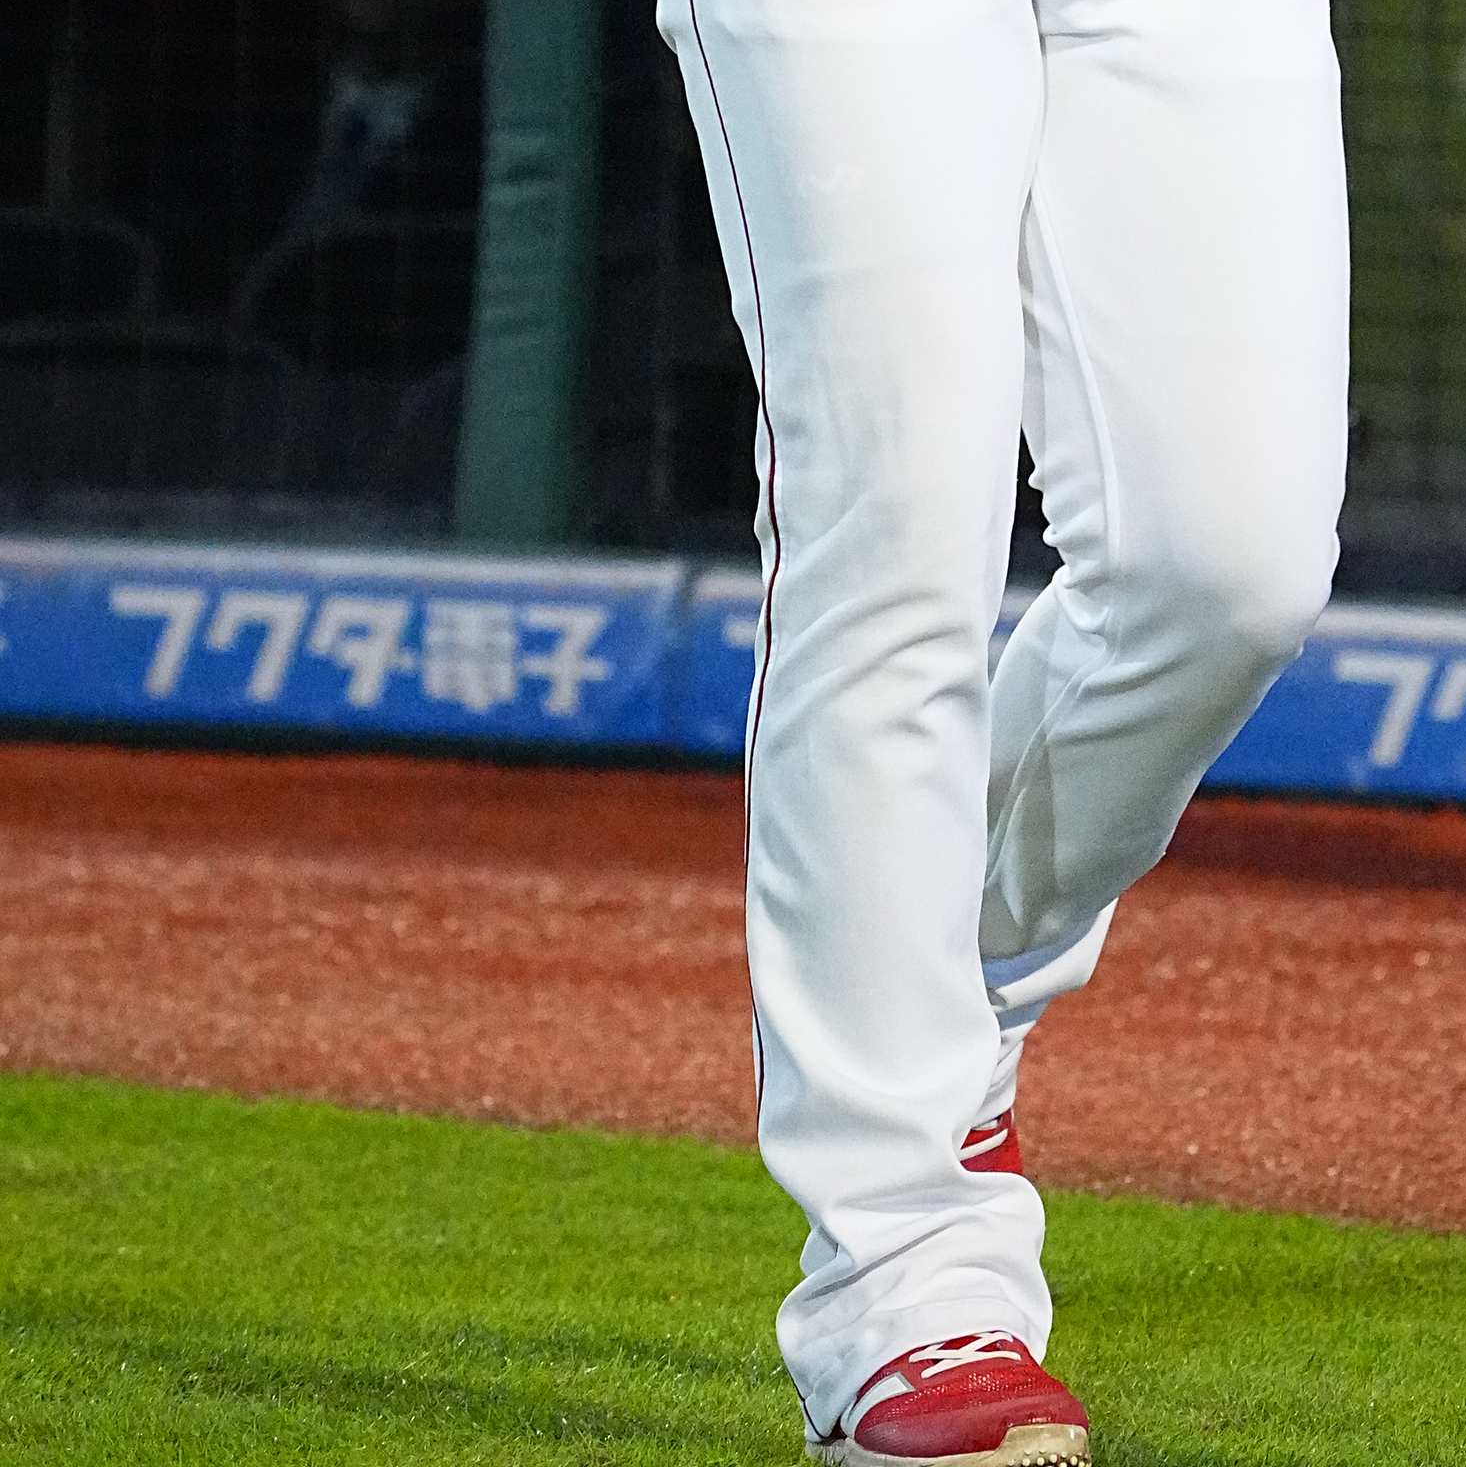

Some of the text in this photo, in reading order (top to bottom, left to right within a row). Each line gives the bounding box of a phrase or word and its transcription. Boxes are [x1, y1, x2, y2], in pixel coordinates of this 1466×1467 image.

[110, 584, 612, 717] フクダ電子
